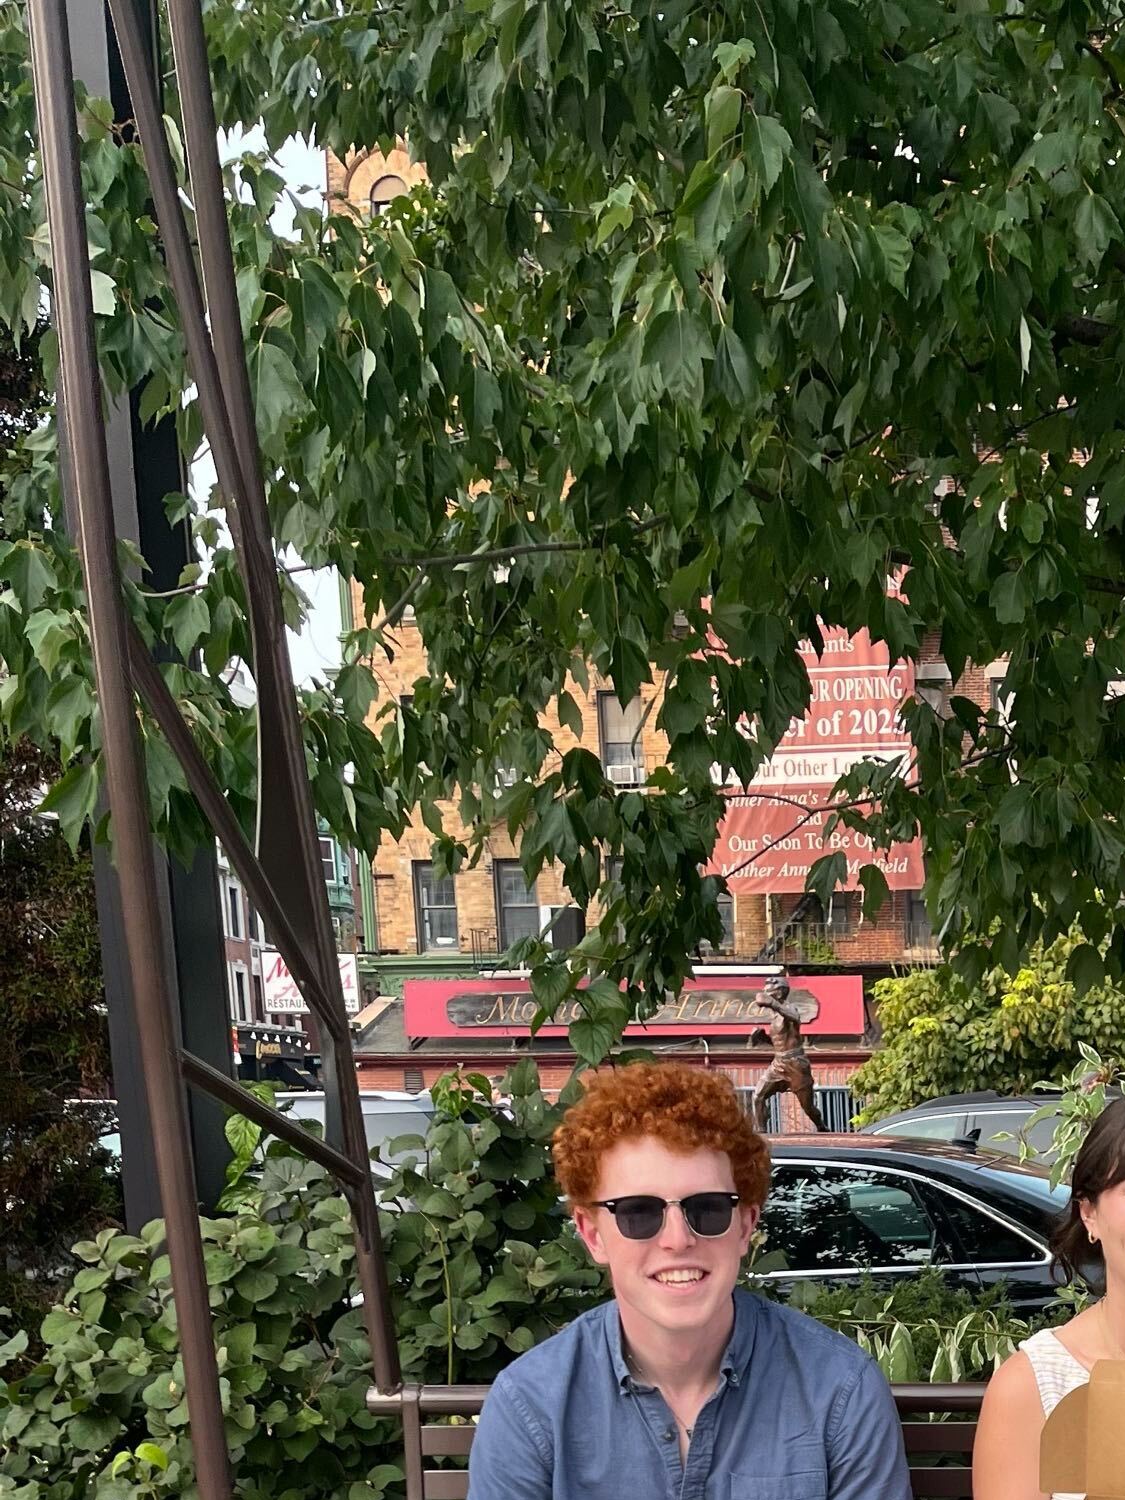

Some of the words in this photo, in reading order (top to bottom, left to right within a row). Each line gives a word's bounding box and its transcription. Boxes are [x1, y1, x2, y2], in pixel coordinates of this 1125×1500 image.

[833, 676, 902, 701] OPENING
[816, 710, 844, 737] of
[784, 759, 828, 777] Other
[728, 835, 758, 852] Our
[762, 834, 801, 851] Soon
[804, 833, 823, 850] To
[829, 832, 851, 849] Be
